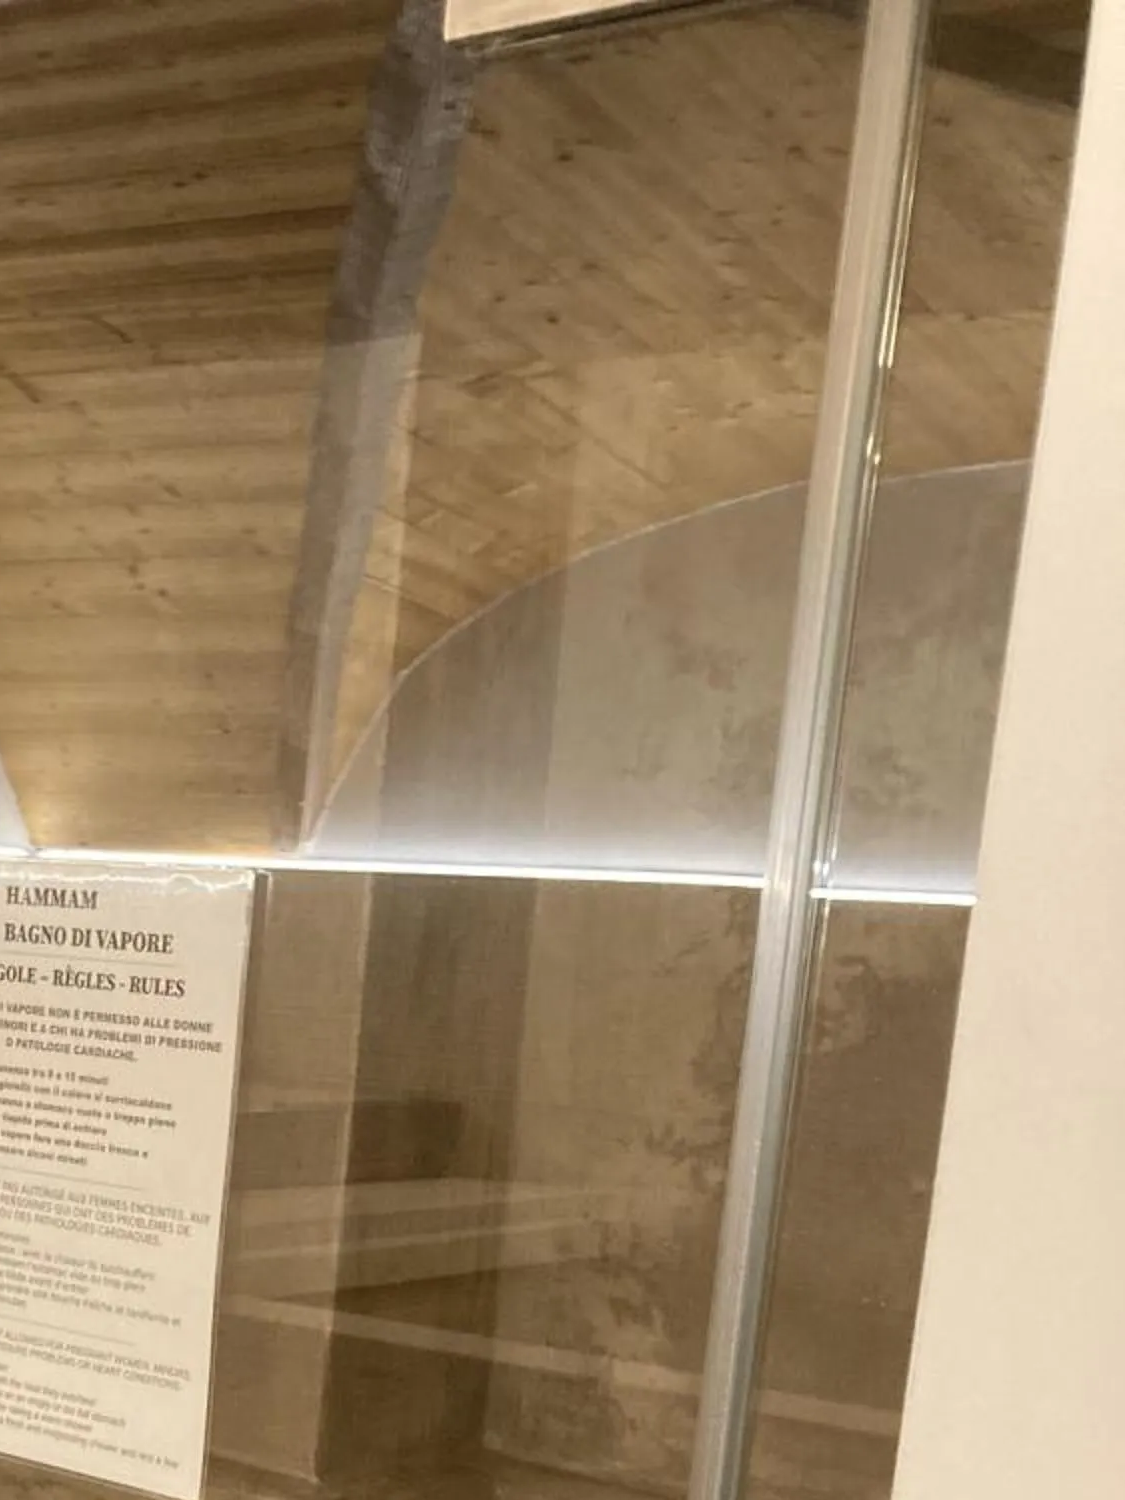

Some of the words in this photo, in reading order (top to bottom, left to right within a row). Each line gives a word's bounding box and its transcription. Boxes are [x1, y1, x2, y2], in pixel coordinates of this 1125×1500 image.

[5, 885, 99, 910] HAMMAM
[3, 922, 67, 946] BAGNO
[70, 927, 93, 948] DI
[95, 928, 175, 955] VAPORE
[52, 962, 117, 991] RÈGLES
[127, 974, 186, 998] RULES
[5, 1001, 45, 1016] VAPORE
[47, 1005, 70, 1019] NON
[82, 1009, 141, 1026] PERMESSO
[142, 1015, 171, 1029] ALLE
[172, 1018, 215, 1033] DONNE
[4, 1036, 14, 1048] O
[14, 1037, 71, 1054] PATOLOGIE
[30, 1021, 37, 1033] E
[49, 1023, 68, 1036] CHI
[69, 1026, 84, 1038] HA
[88, 1028, 142, 1045] PROBLEMI
[143, 1033, 156, 1046] DI
[158, 1035, 223, 1054] PRESSIONE
